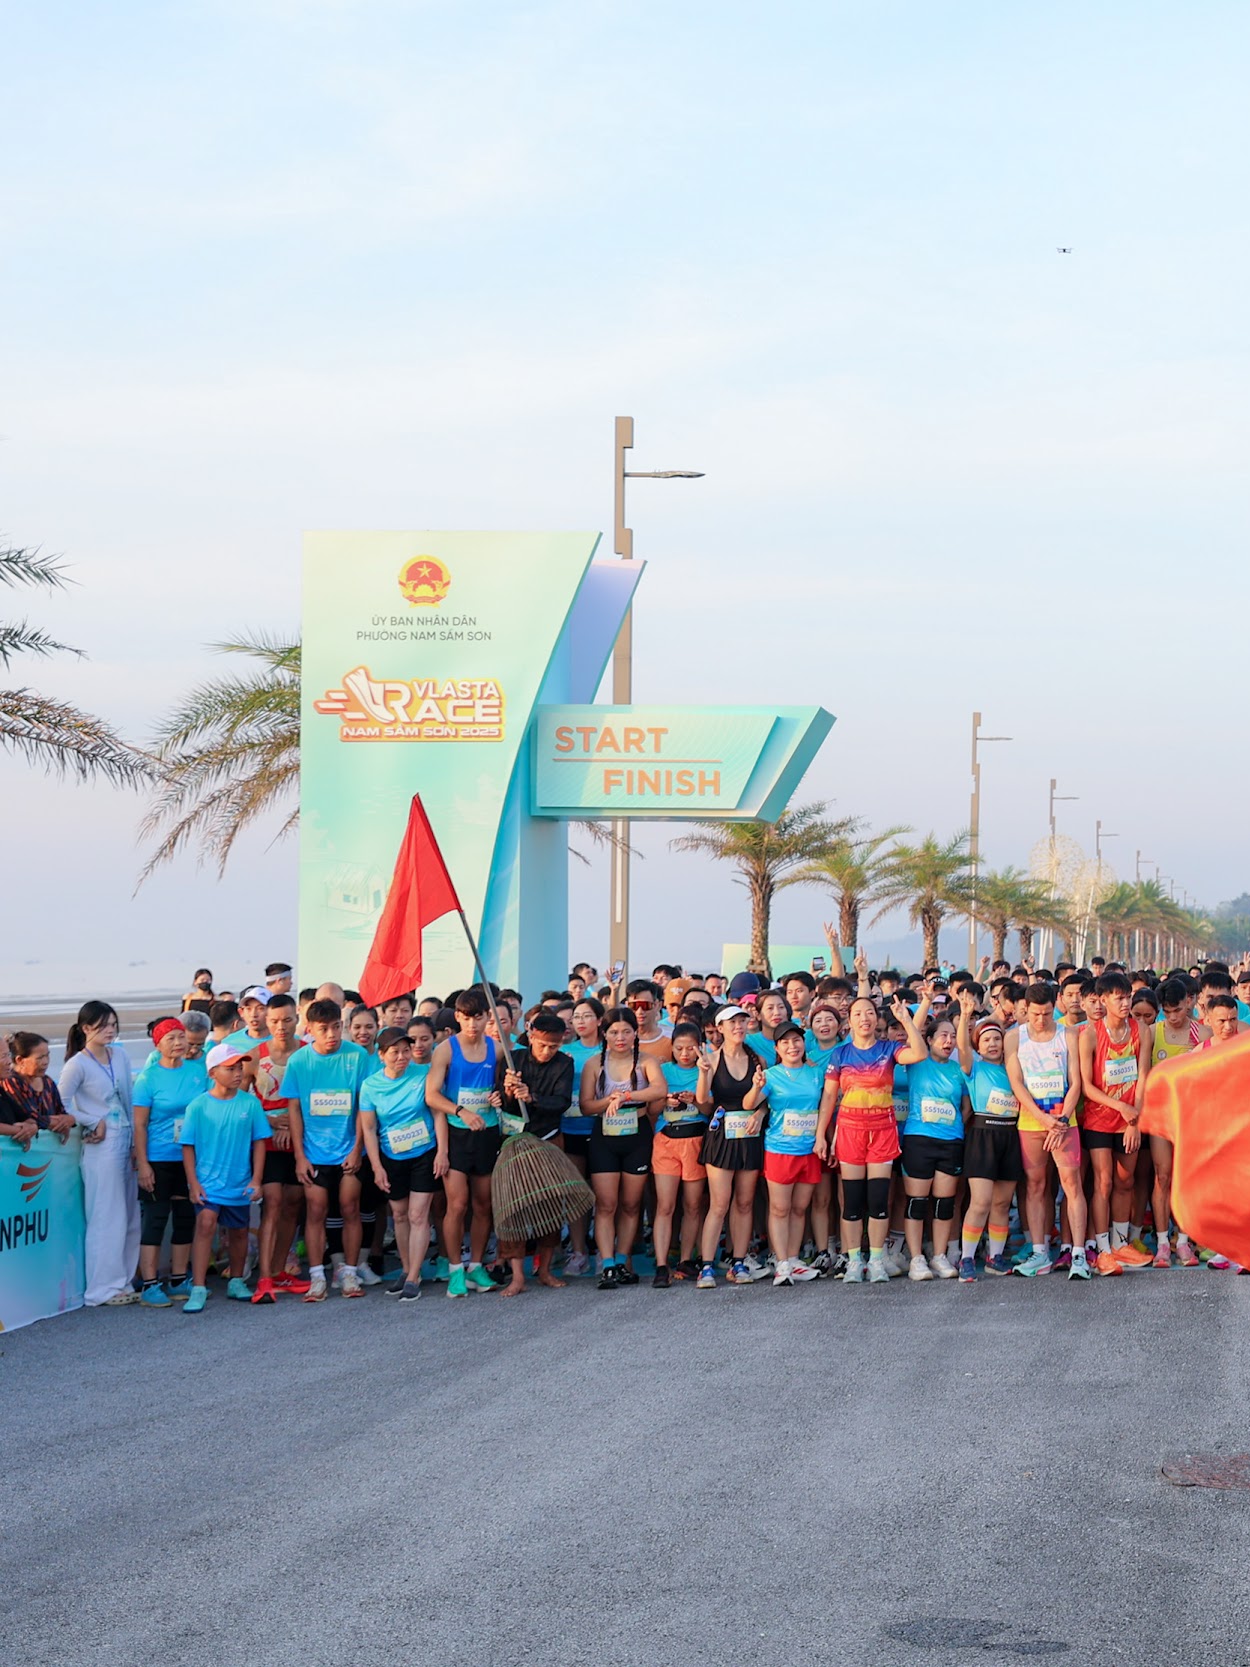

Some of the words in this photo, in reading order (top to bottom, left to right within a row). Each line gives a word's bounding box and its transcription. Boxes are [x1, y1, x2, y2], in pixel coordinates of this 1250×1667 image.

[390, 616, 414, 626] BAN
[416, 614, 449, 626] NHÂN
[452, 614, 477, 626] DÂN
[410, 631, 436, 641] NAM
[412, 681, 500, 699] VLASTA
[343, 727, 380, 737] NAM
[460, 727, 499, 737] 2025
[555, 726, 669, 753] START
[603, 769, 721, 796] FINISH
[1109, 1065, 1134, 1077] SS50351
[924, 1105, 953, 1116] SS51040
[605, 1118, 635, 1127] SS50241
[786, 1119, 816, 1127] SS50905
[0, 1209, 49, 1252] NPHU
